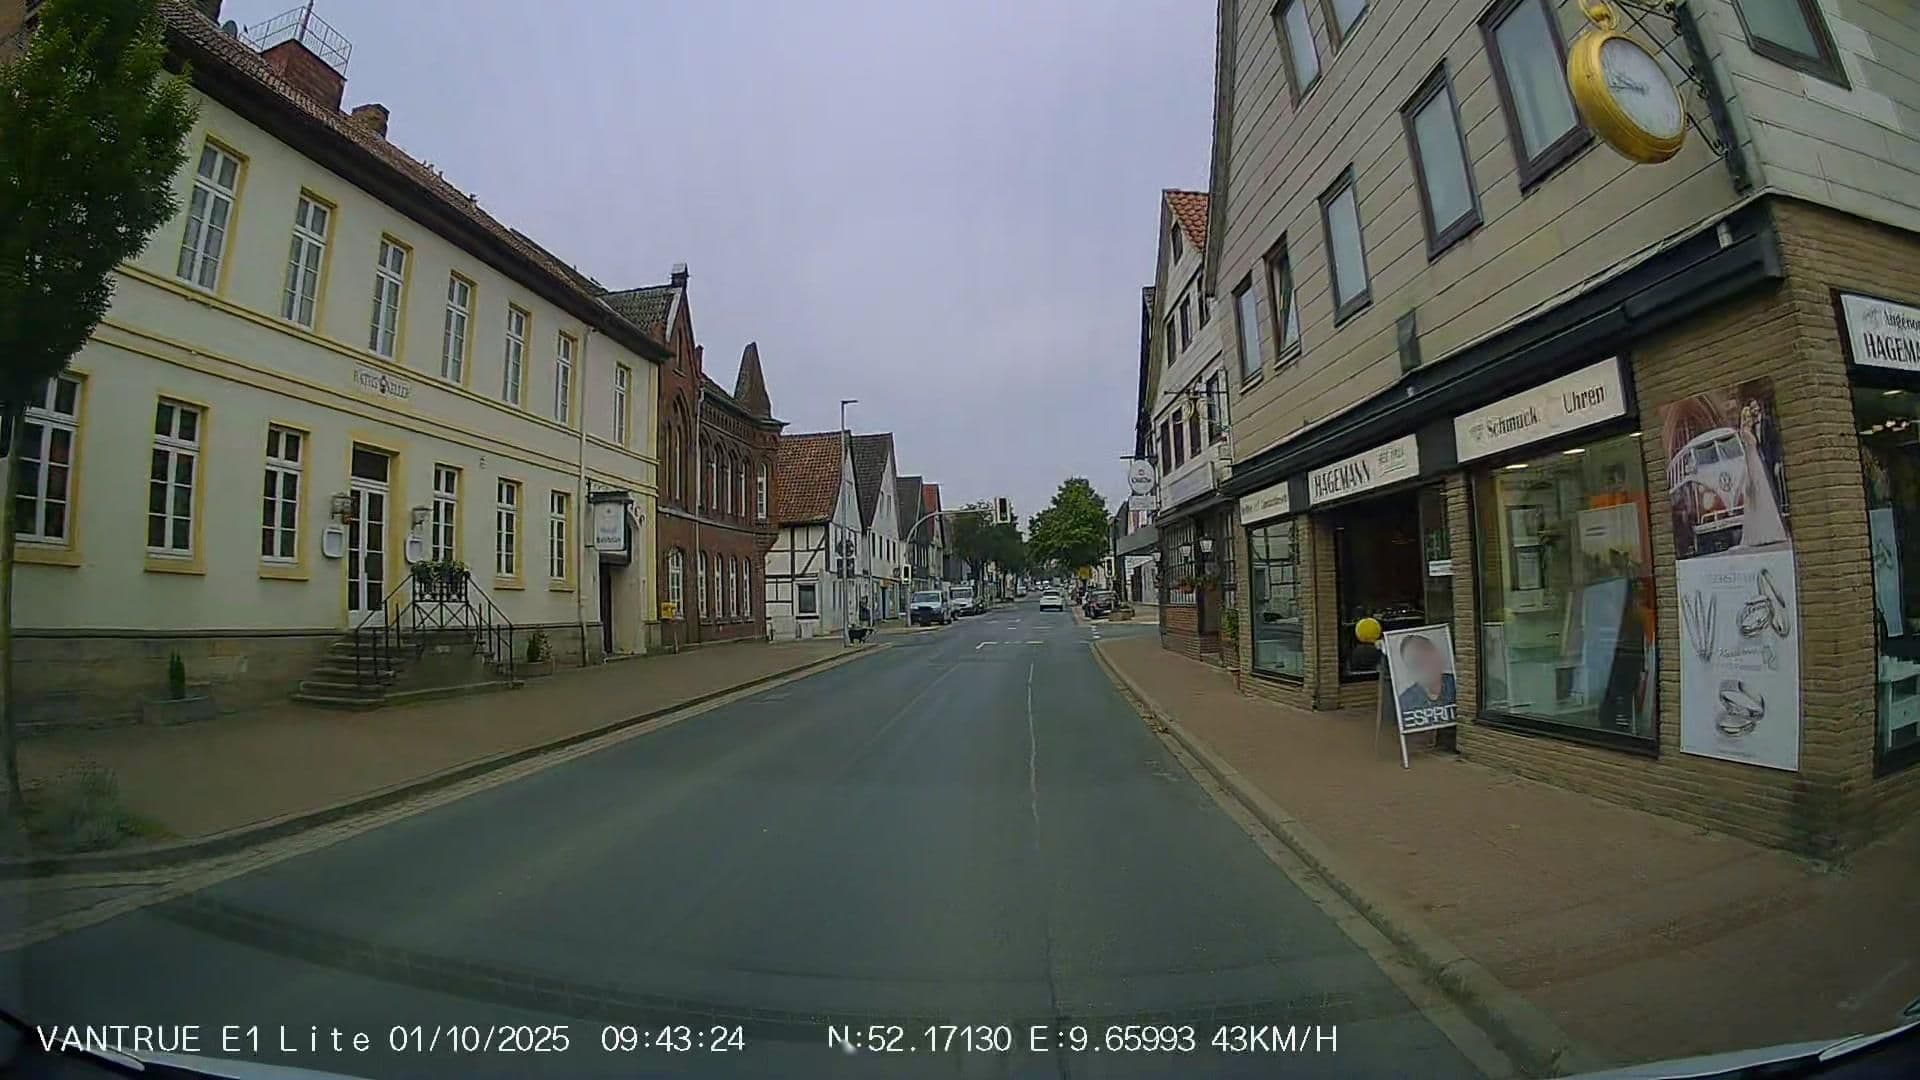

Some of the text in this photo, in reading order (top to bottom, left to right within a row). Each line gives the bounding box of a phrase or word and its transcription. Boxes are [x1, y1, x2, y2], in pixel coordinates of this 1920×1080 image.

[1486, 384, 1606, 440] Schmuck Uhren
[1313, 459, 1370, 498] HAGEMANN
[1402, 703, 1457, 728] ESPRIT
